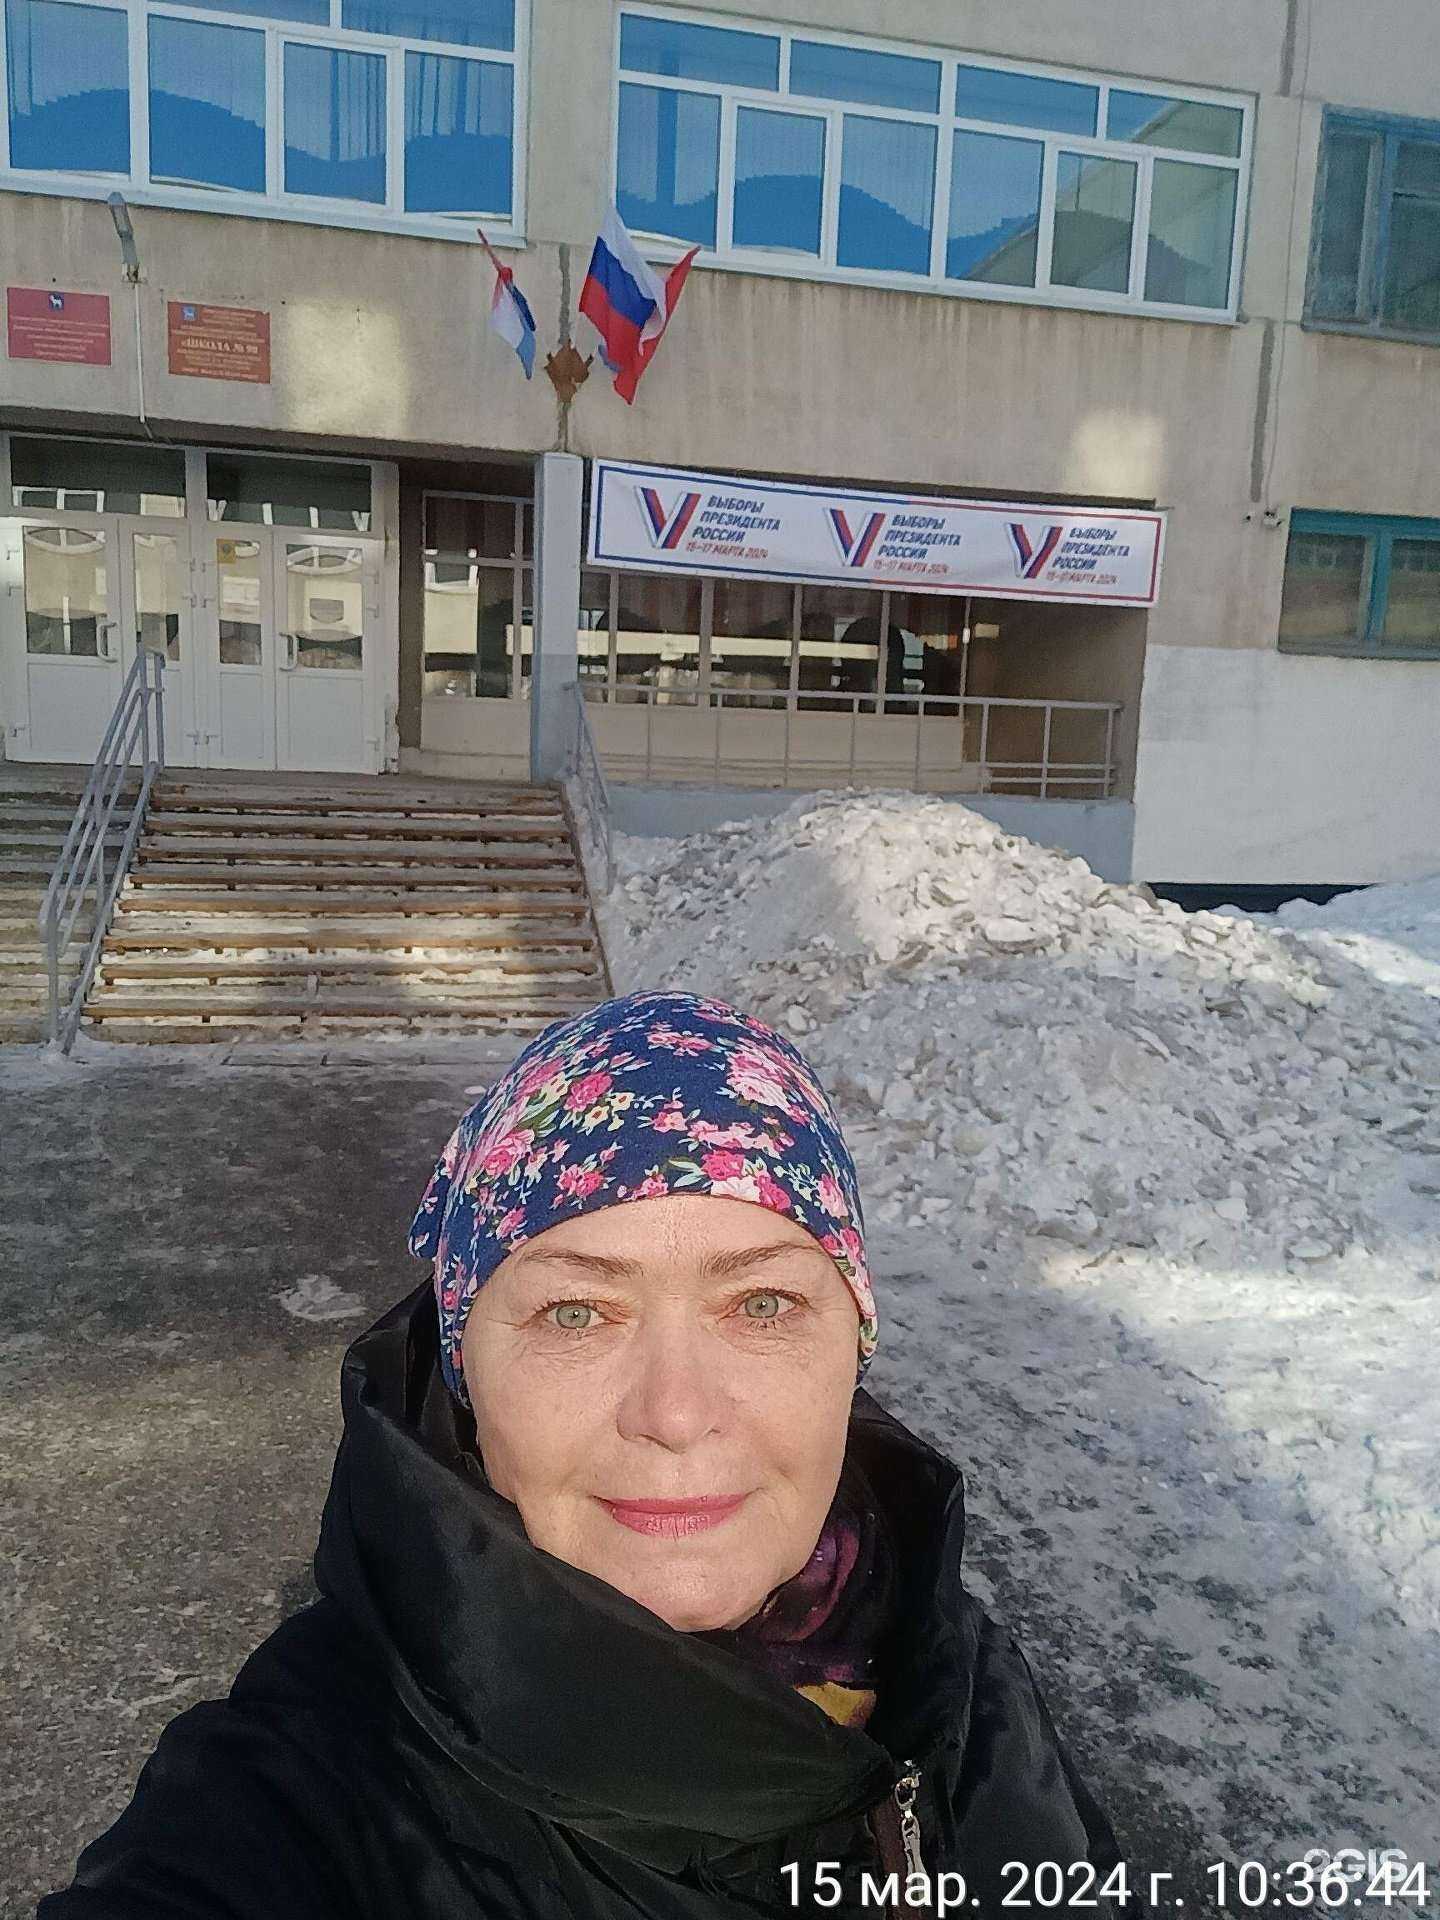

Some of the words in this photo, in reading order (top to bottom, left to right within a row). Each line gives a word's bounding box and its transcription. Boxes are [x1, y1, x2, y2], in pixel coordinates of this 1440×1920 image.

[707, 495, 765, 513] ВЫБОРЫ
[700, 511, 781, 530] ПРЕЗИДЕНТА
[892, 514, 946, 530] ВЫБОРЫ
[692, 527, 746, 543] РОССИИ
[884, 529, 962, 546] ПРЕЗИДЕНТА
[1069, 527, 1118, 540] ВЫБОРЫ
[712, 544, 745, 557] МАРТА
[745, 547, 769, 559] 2024
[878, 545, 928, 559] РОССИИ
[1061, 541, 1130, 557] ПРЕЗИДЕНТА
[1052, 556, 1099, 570] РОССИИ
